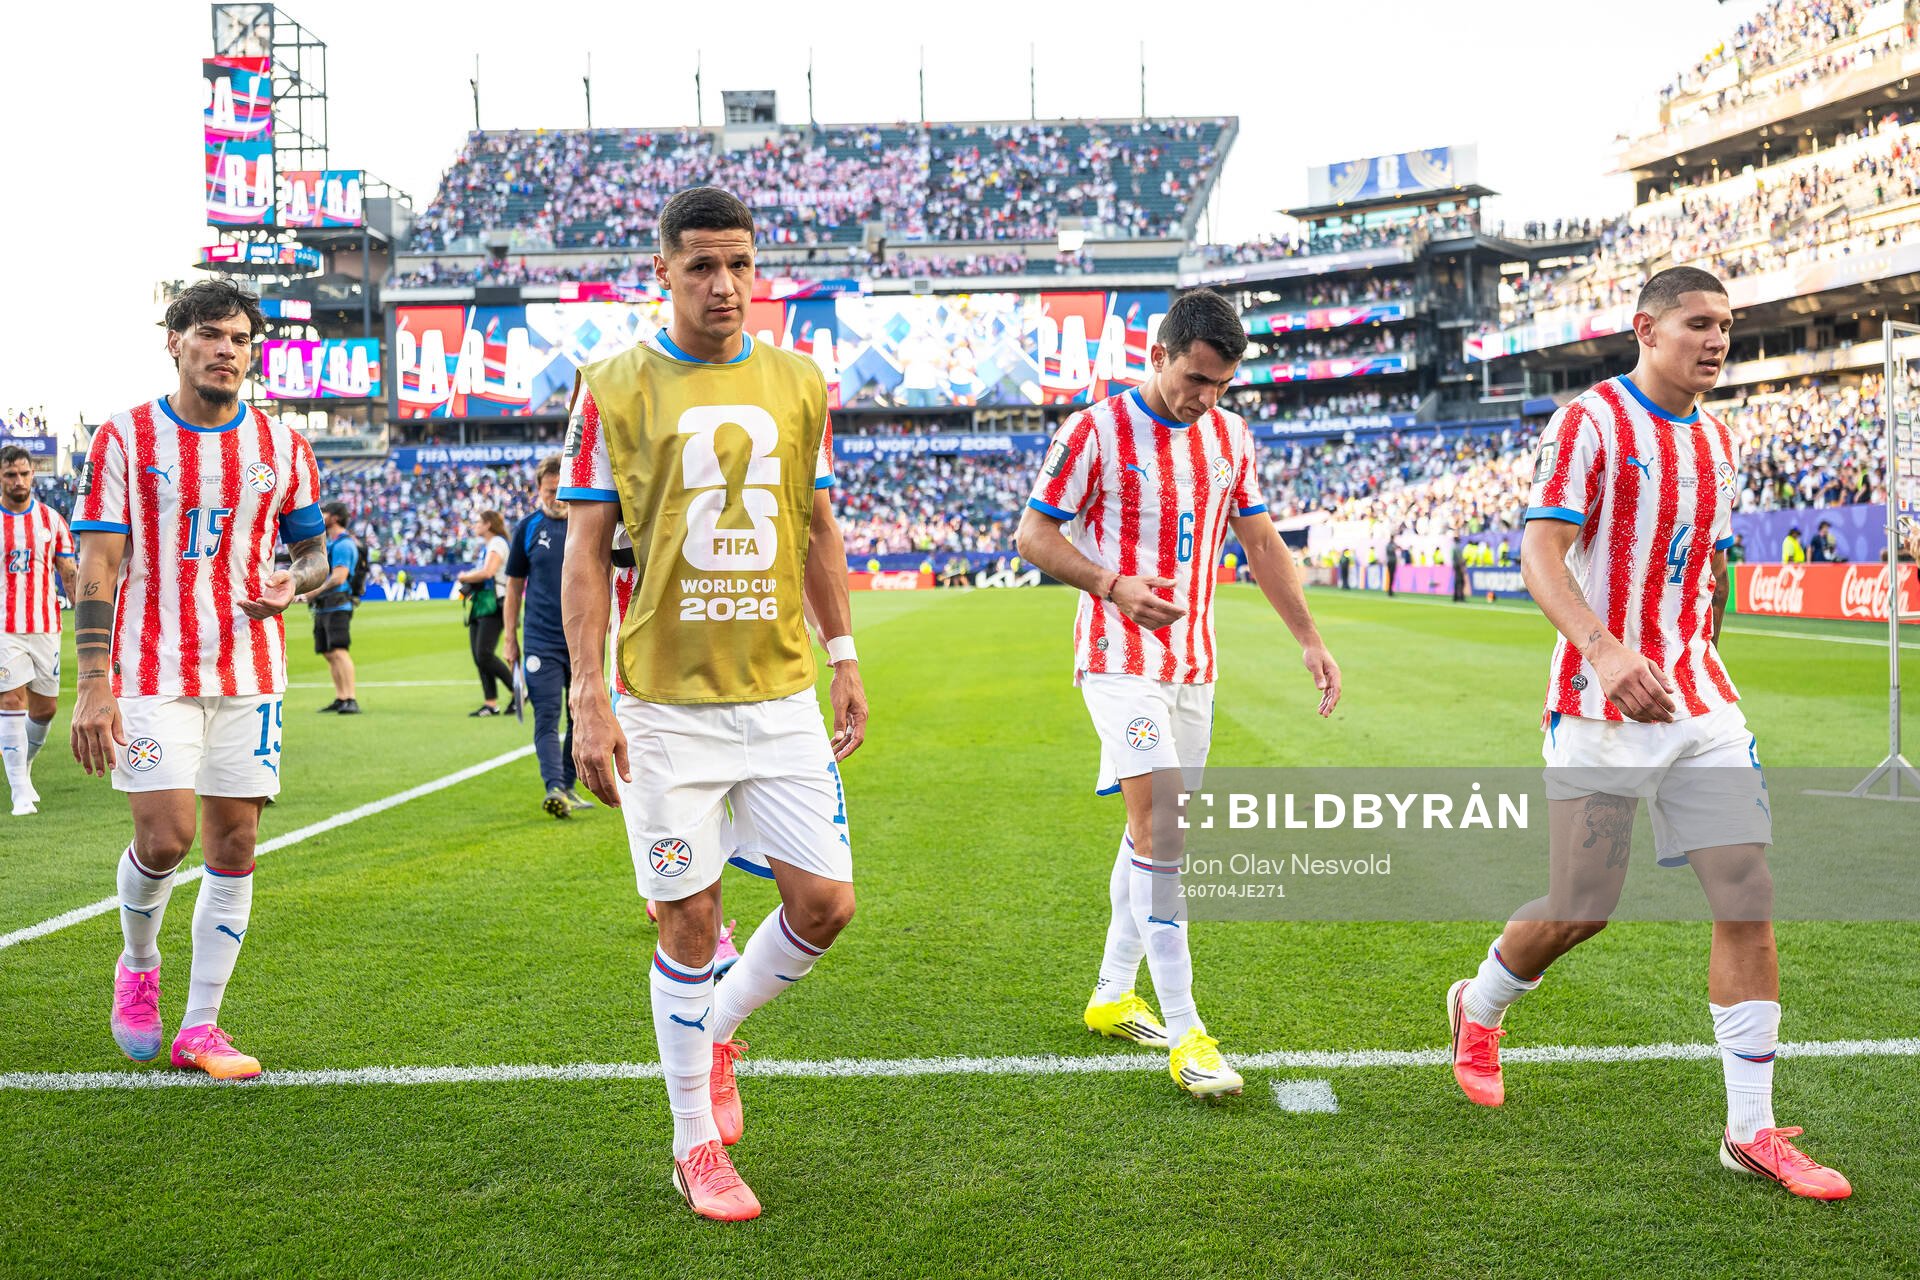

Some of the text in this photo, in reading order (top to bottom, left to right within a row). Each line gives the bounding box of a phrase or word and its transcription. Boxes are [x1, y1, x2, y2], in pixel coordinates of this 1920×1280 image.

[1272, 415, 1392, 435] PHILADELPHIA
[416, 449, 449, 463] FIFA
[449, 447, 502, 463] WORLD
[503, 446, 533, 461] CUP
[842, 438, 875, 453] FIFA
[875, 437, 929, 453] WORLD
[929, 437, 959, 451] CUP
[182, 507, 233, 560] 15
[1177, 510, 1195, 563] 6
[713, 538, 759, 555] FIFA
[1667, 523, 1694, 586] 4
[8, 548, 32, 574] 21
[680, 579, 777, 594] WORLD CUP
[679, 597, 778, 621] 2026
